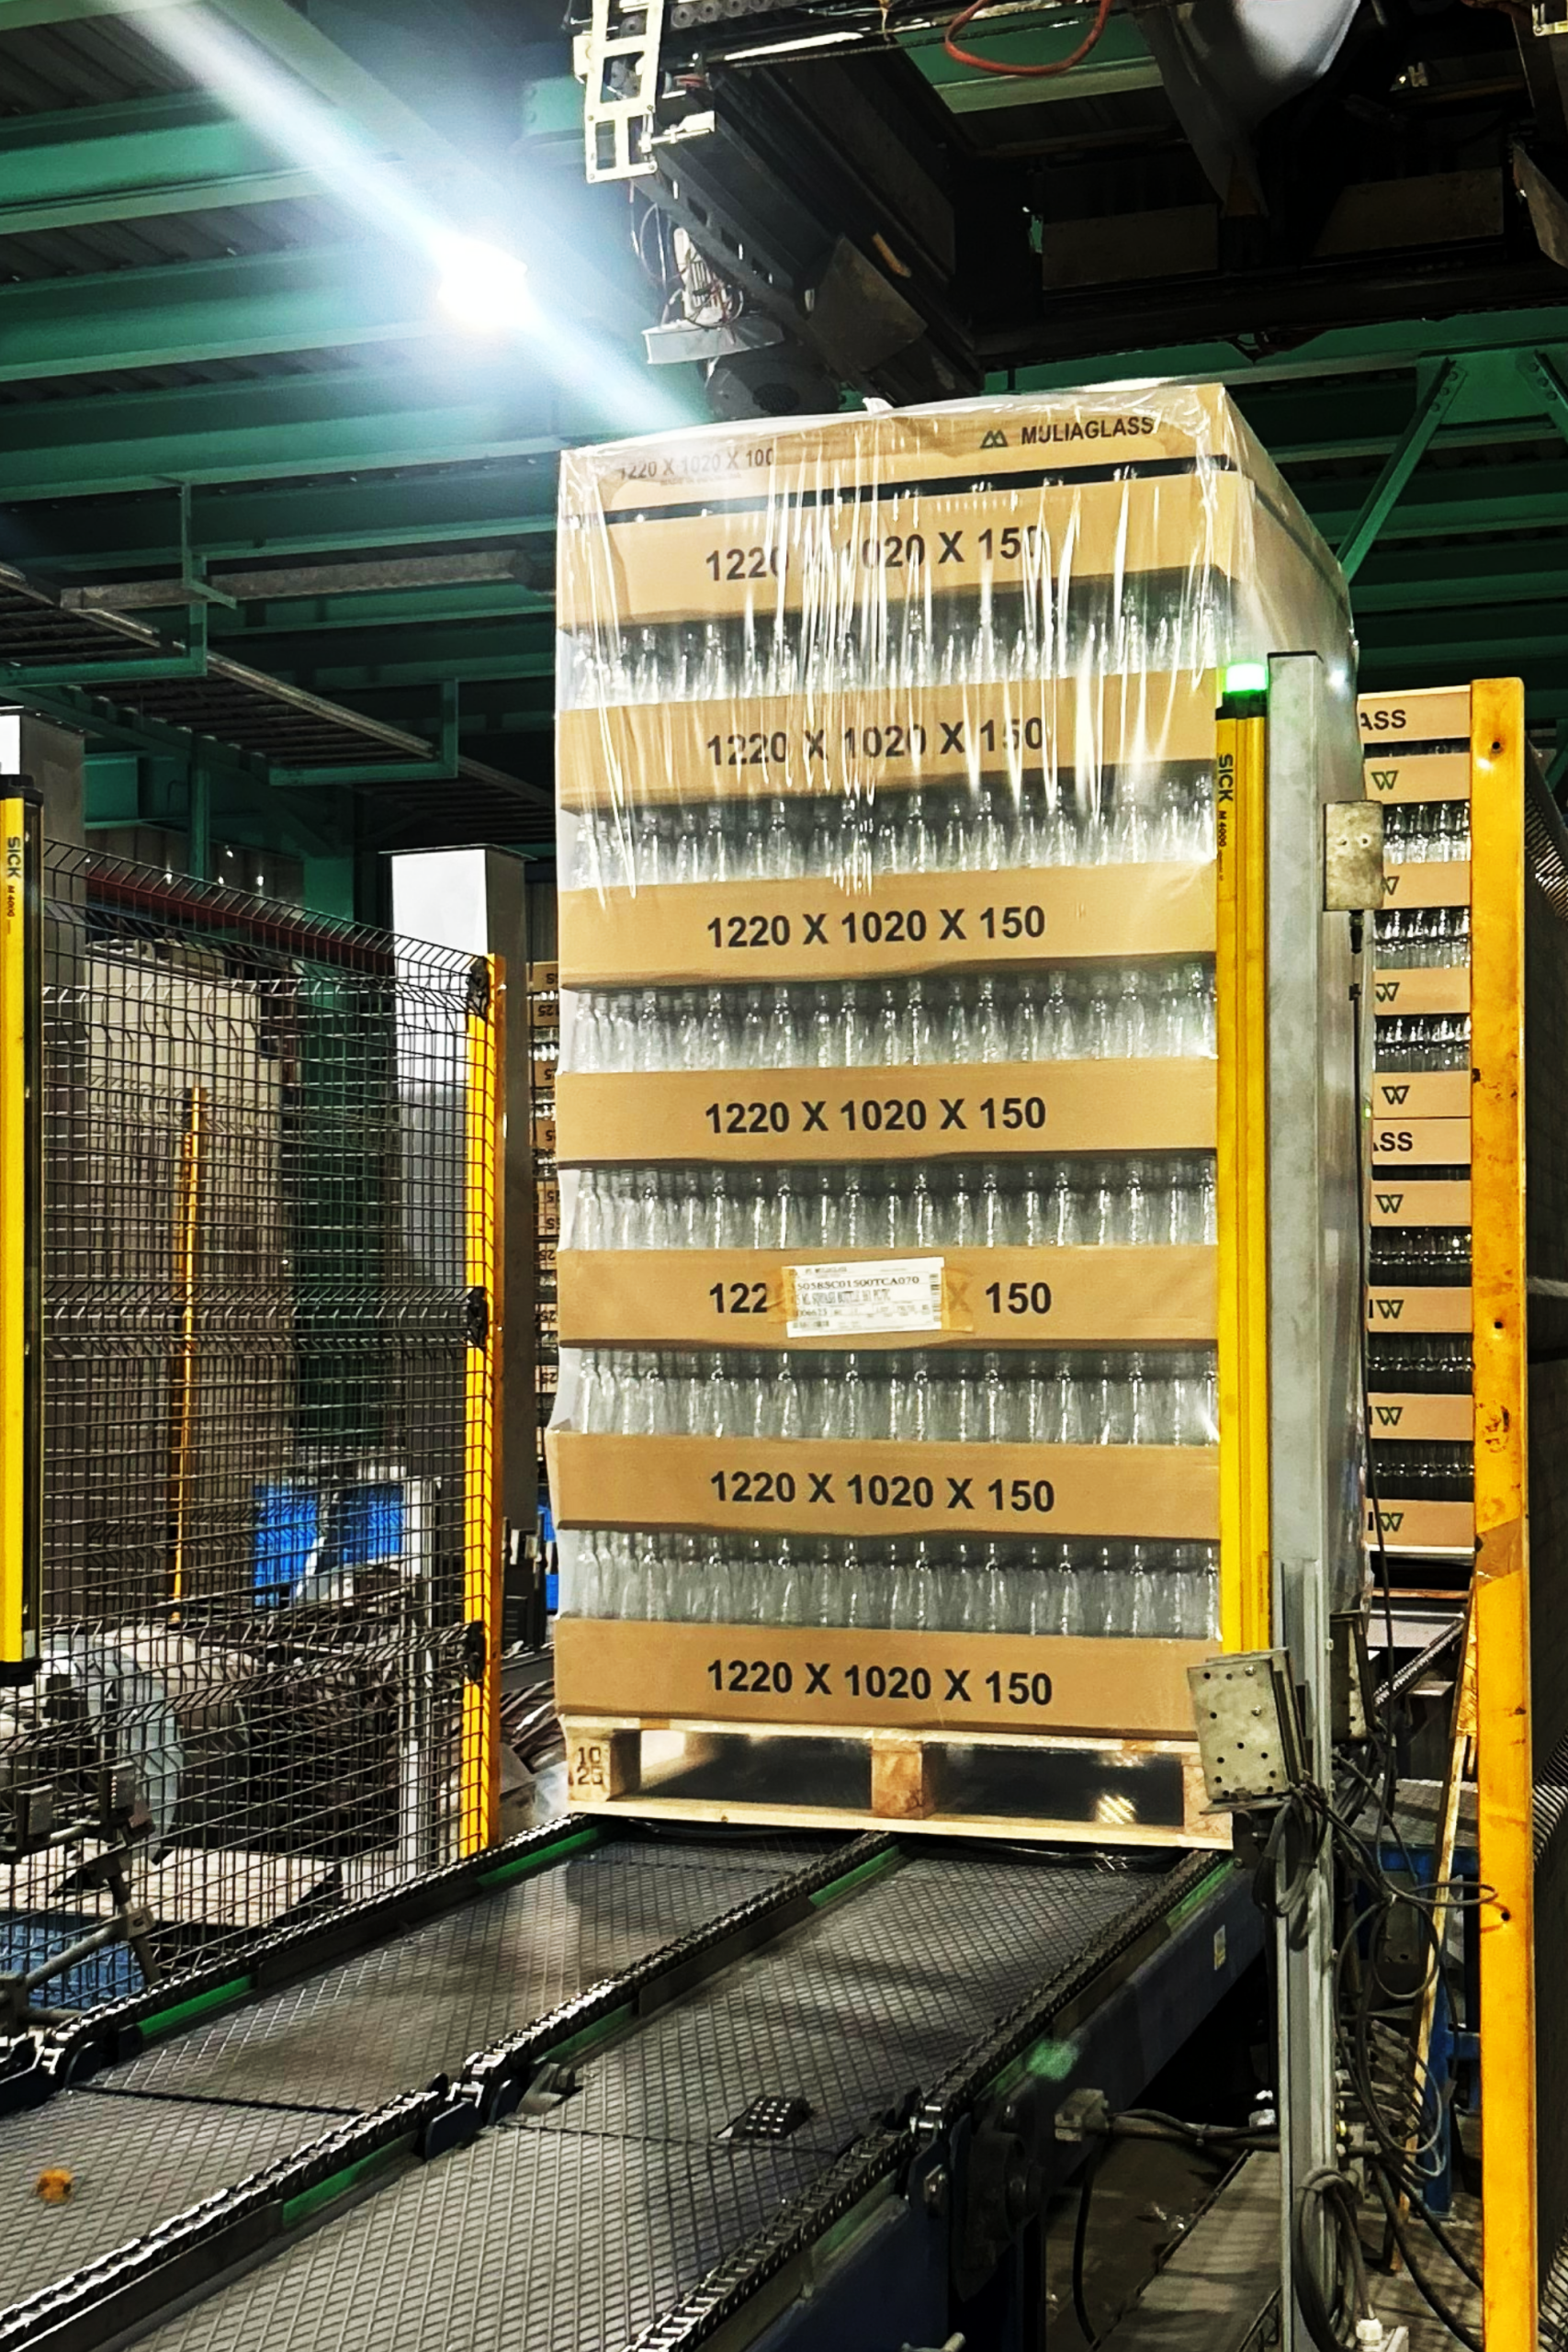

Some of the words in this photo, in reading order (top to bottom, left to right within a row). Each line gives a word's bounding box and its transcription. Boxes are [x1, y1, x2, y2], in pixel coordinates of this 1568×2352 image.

[1021, 416, 1154, 445] MULIAGLASS
[938, 530, 964, 564] X
[707, 731, 787, 766] 1220
[804, 729, 828, 761] X
[843, 723, 926, 759] 1020
[940, 721, 964, 754] X
[1218, 753, 1234, 803] SICK
[7, 836, 21, 878] SICK
[707, 915, 791, 948] 1220
[803, 912, 829, 944] X
[841, 910, 927, 943] 1020
[940, 908, 967, 941] X
[980, 905, 1045, 939] 150
[705, 1102, 789, 1134] 1220
[801, 1101, 829, 1131] X
[840, 1099, 927, 1131] 1020
[940, 1098, 967, 1129] X
[980, 1096, 1045, 1129] 150
[986, 1282, 1052, 1314] 150
[711, 1470, 795, 1502] 1220
[808, 1472, 835, 1503] X
[847, 1474, 933, 1508] 1020
[947, 1477, 975, 1510] X
[988, 1478, 1055, 1512] 150
[707, 1659, 793, 1693] 1220
[805, 1662, 831, 1695] X
[844, 1664, 931, 1700] 1020
[944, 1668, 971, 1702] X
[986, 1670, 1052, 1705] 150
[578, 1747, 602, 1764] 10
